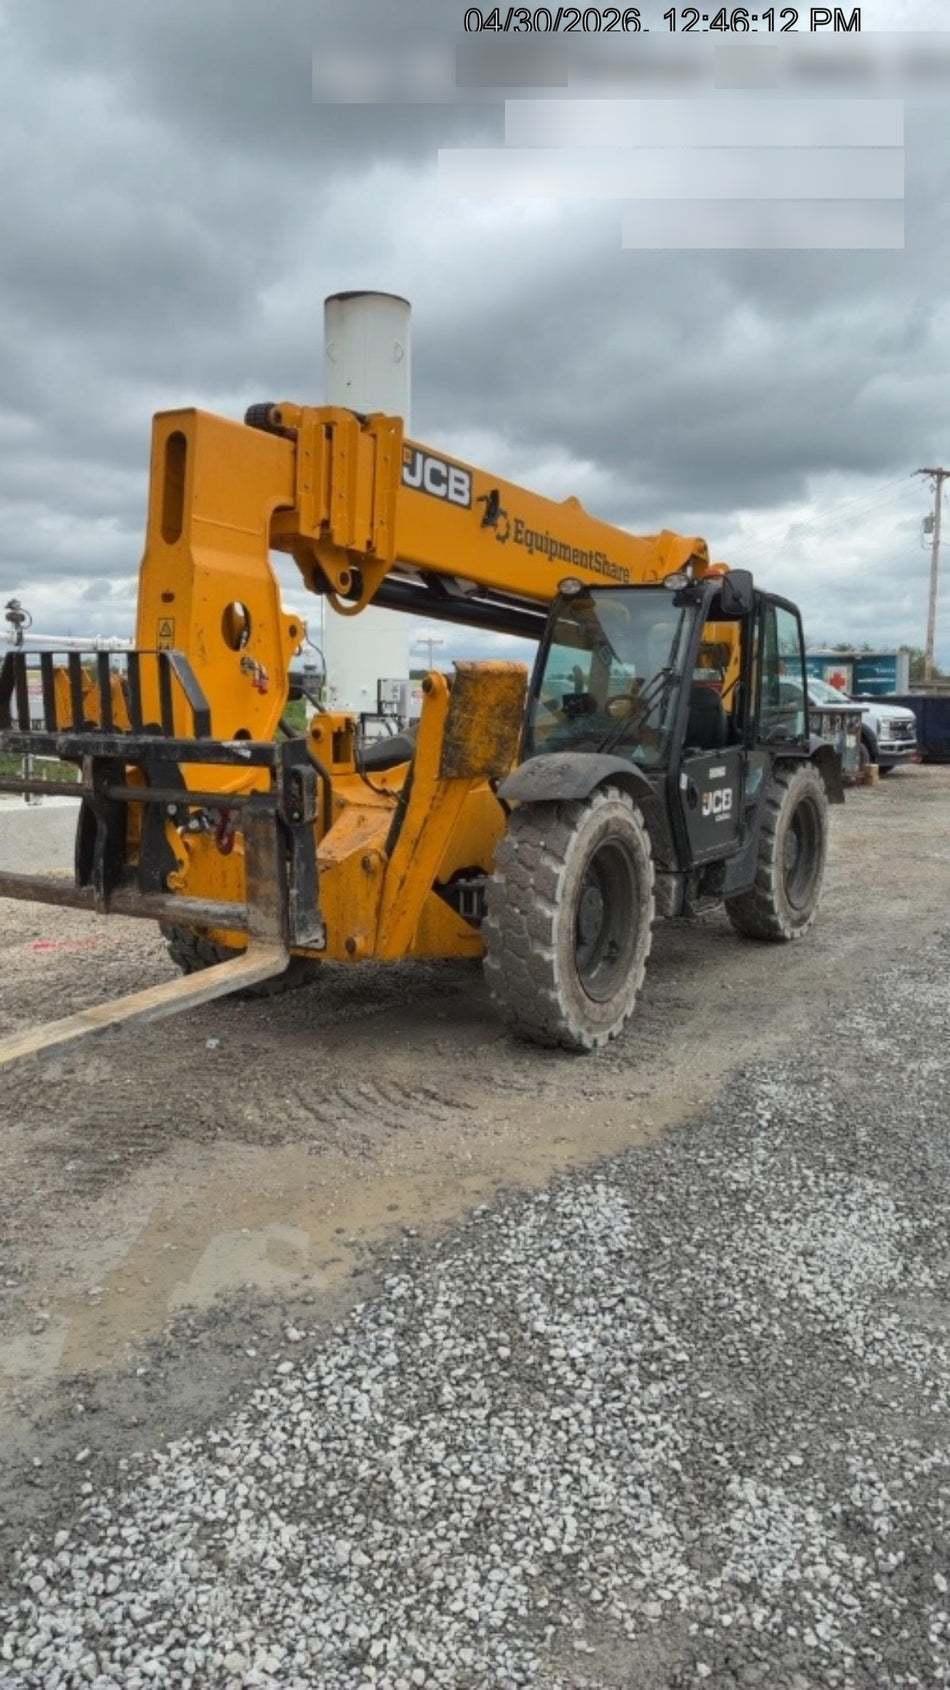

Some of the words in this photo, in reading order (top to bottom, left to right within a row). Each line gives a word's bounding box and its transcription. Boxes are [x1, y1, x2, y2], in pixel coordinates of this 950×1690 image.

[403, 451, 470, 506] JCB
[513, 517, 630, 583] EquipmentShare
[702, 788, 733, 816] JCB
